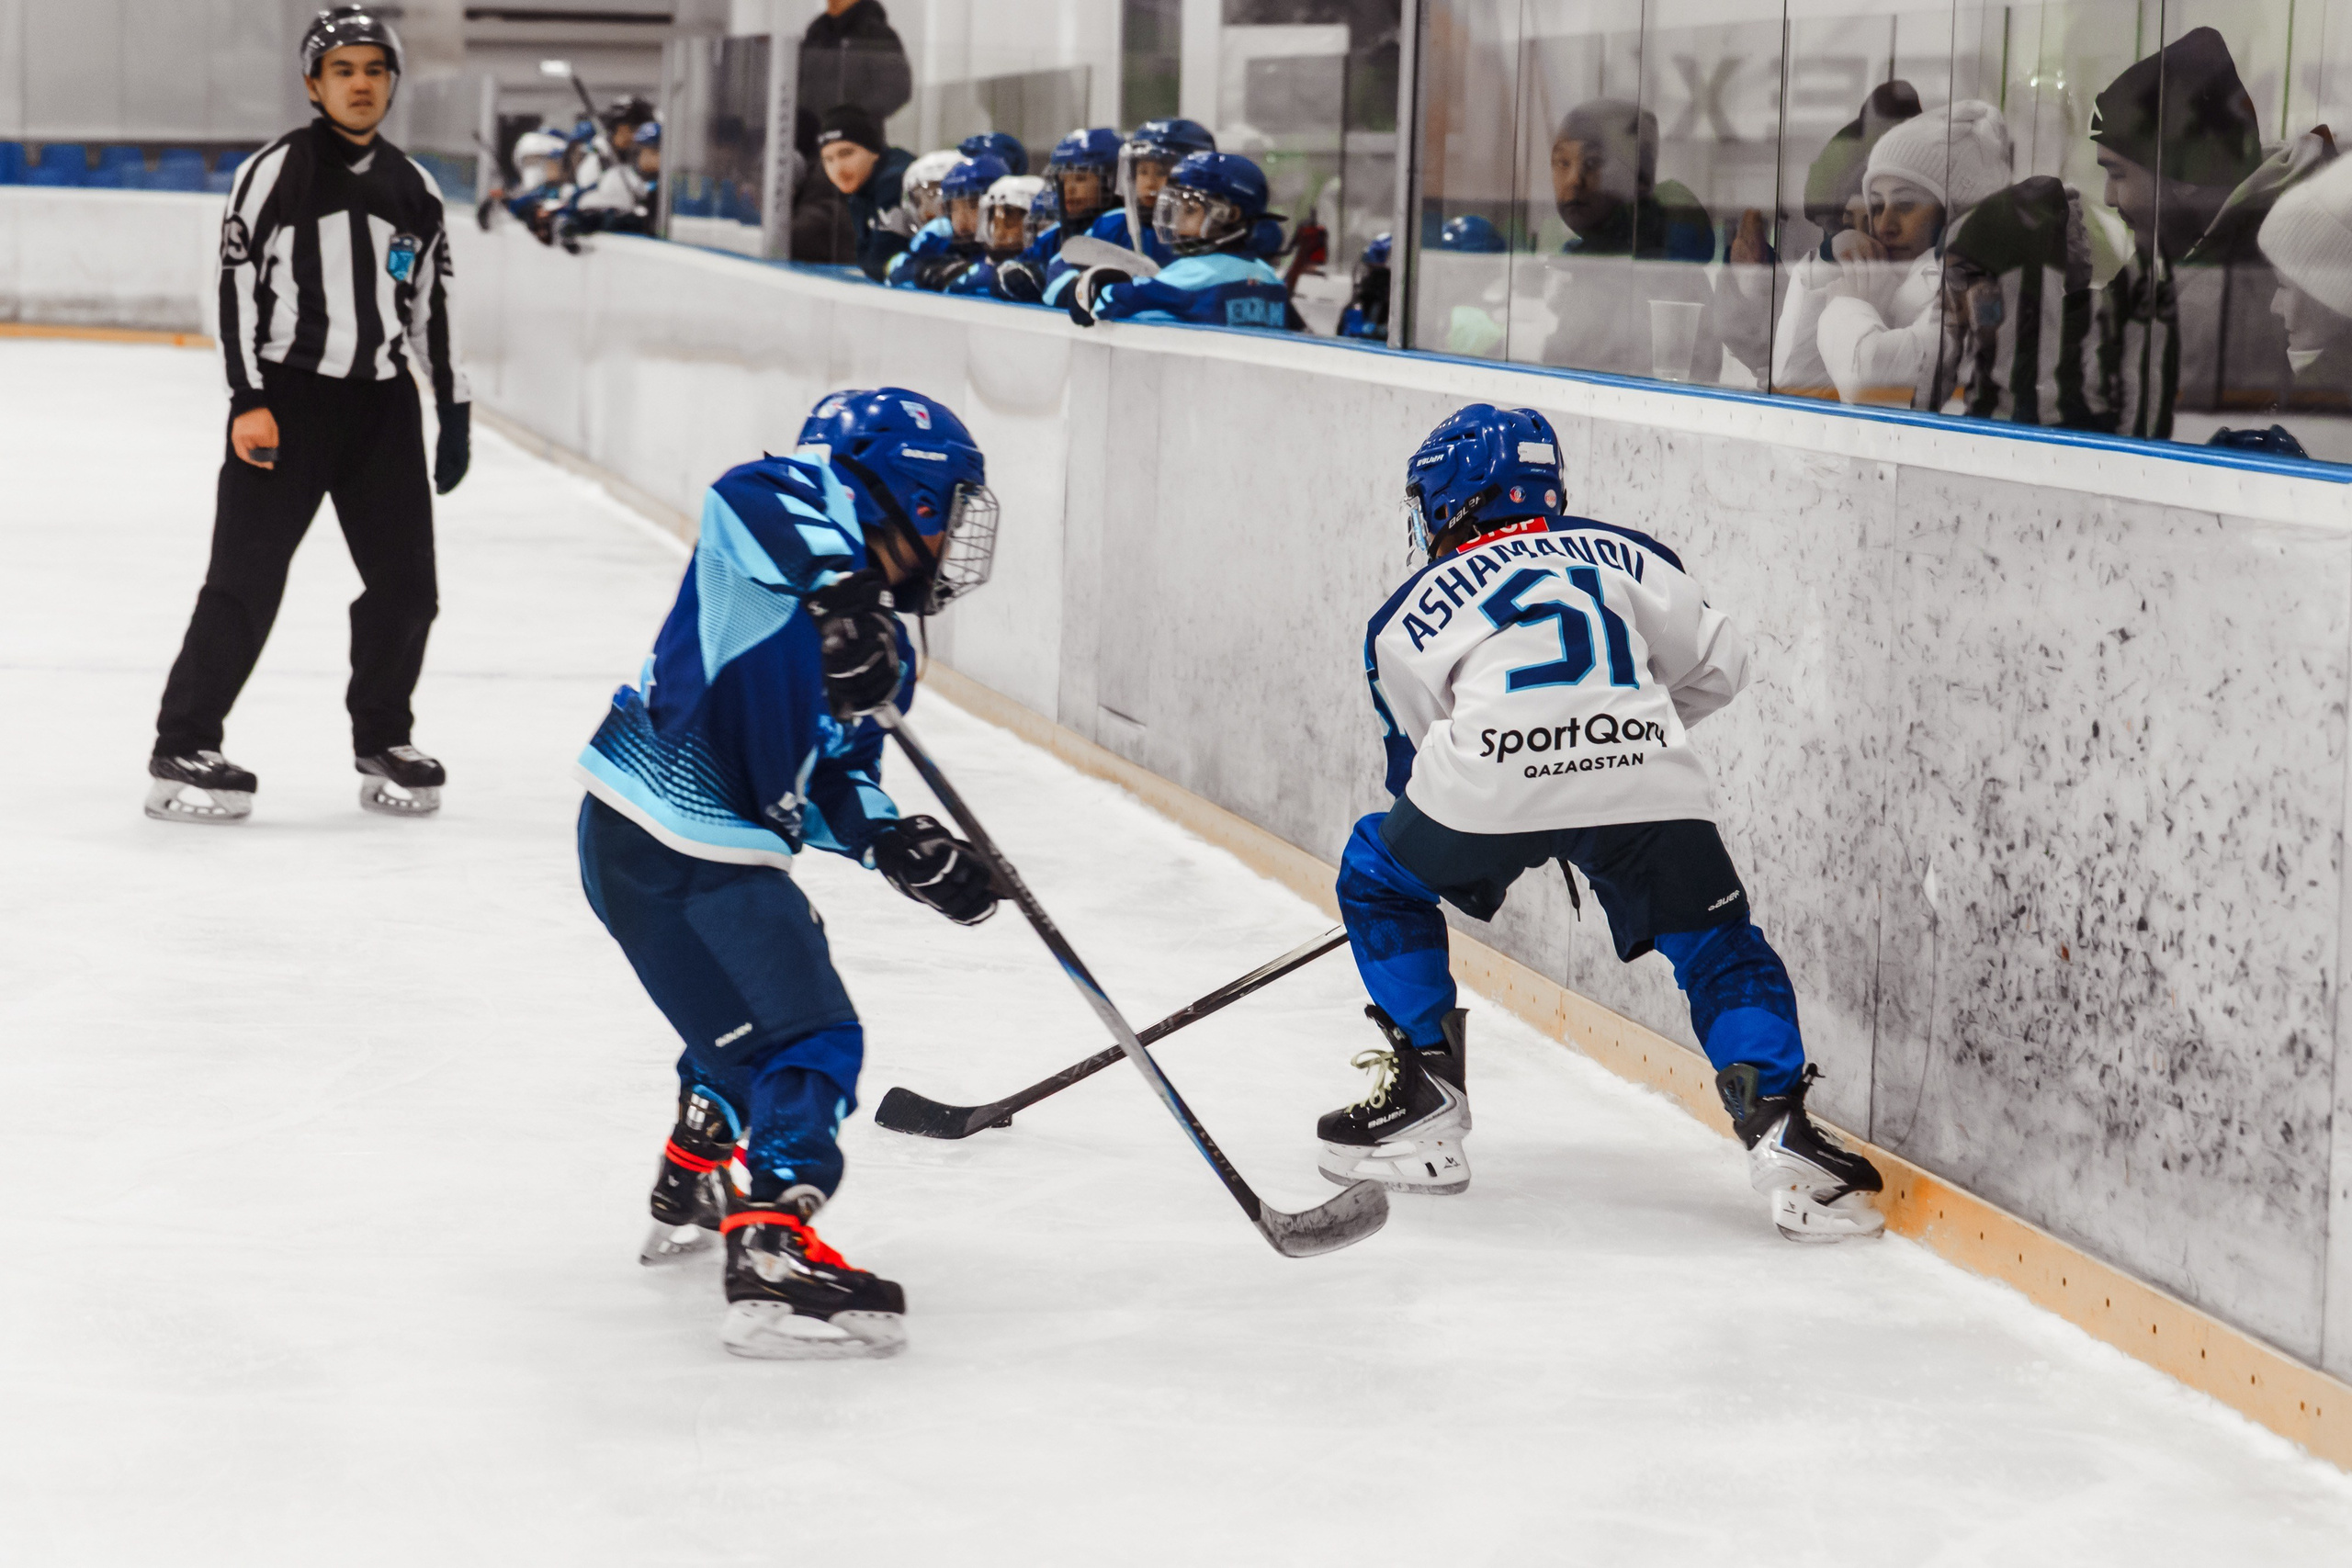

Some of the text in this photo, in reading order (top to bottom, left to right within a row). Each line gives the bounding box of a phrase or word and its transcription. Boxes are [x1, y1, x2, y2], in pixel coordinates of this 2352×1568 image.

[1401, 536, 1645, 654] ASHAMANOV
[1477, 565, 1640, 694] 51
[1523, 752, 1644, 779] QAZAQSTAN
[1367, 1108, 1407, 1129] BAUER
